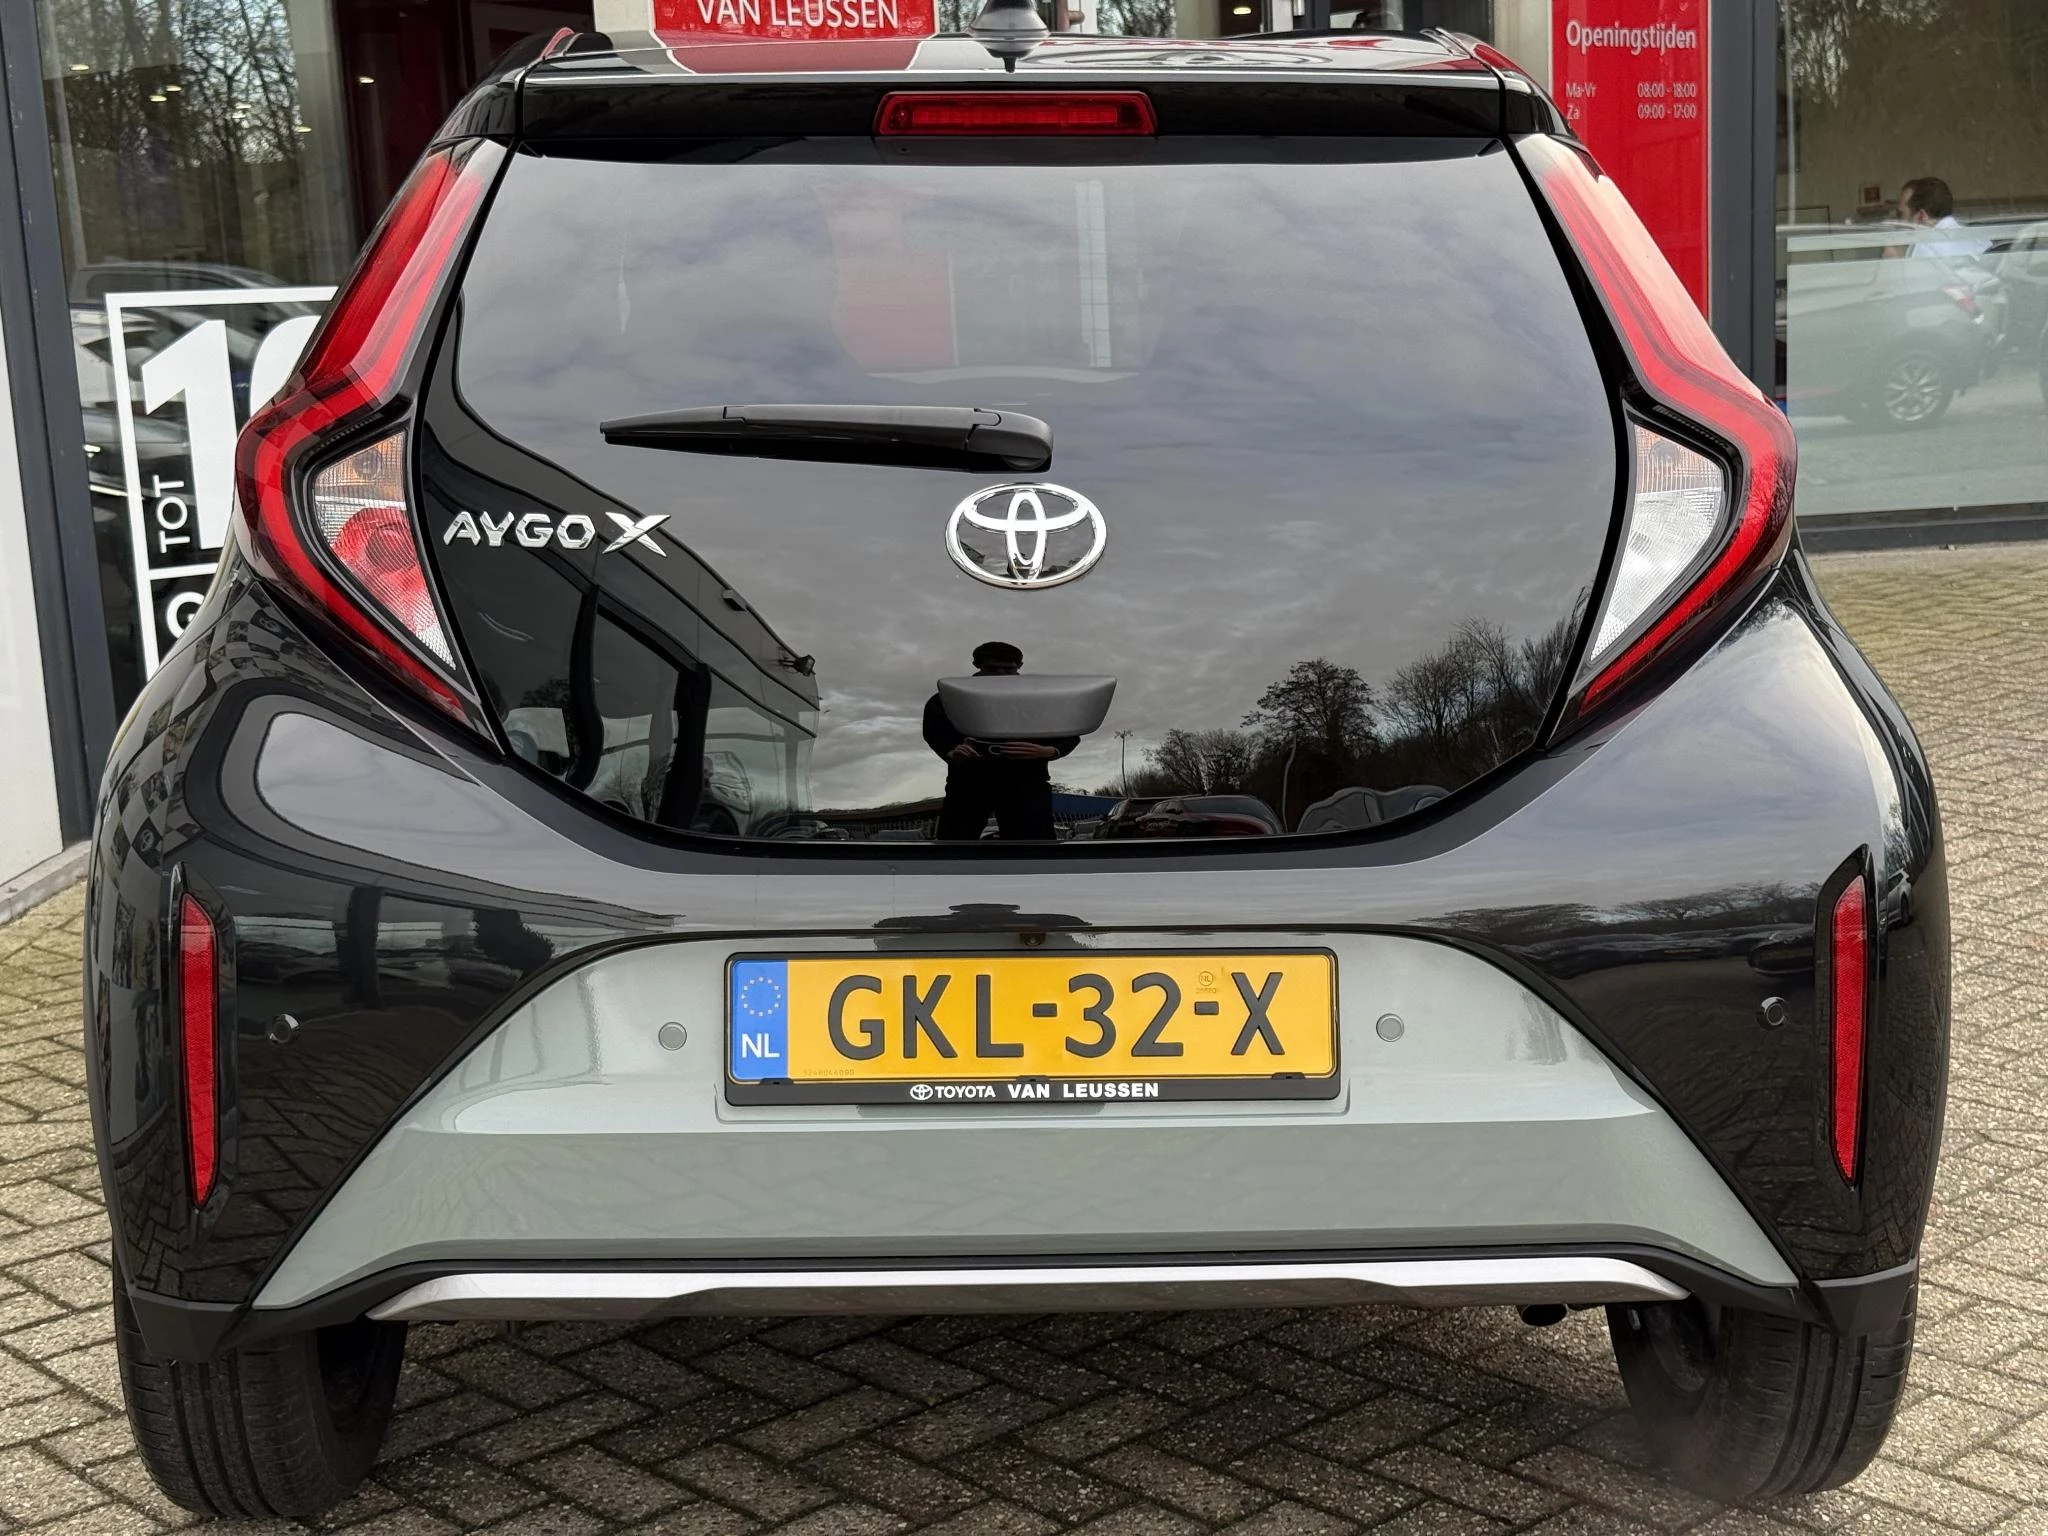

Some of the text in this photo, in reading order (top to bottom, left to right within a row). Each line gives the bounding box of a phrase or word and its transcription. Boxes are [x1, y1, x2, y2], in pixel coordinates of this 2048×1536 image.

[697, 0, 899, 29] VAN LEUSSEN
[1566, 20, 1697, 55] Openingstijden
[1565, 82, 1597, 98] Ma-Vr
[1637, 82, 1665, 98] 08:00
[1566, 104, 1580, 120] Za
[1637, 104, 1665, 119] 09:00
[152, 474, 190, 553] TOT
[443, 511, 672, 557] AYGO X
[828, 971, 1286, 1062] GKL-32-X
[741, 1033, 780, 1059] NL
[934, 1083, 1160, 1099] TOYOTA VAN LEUSSEN
